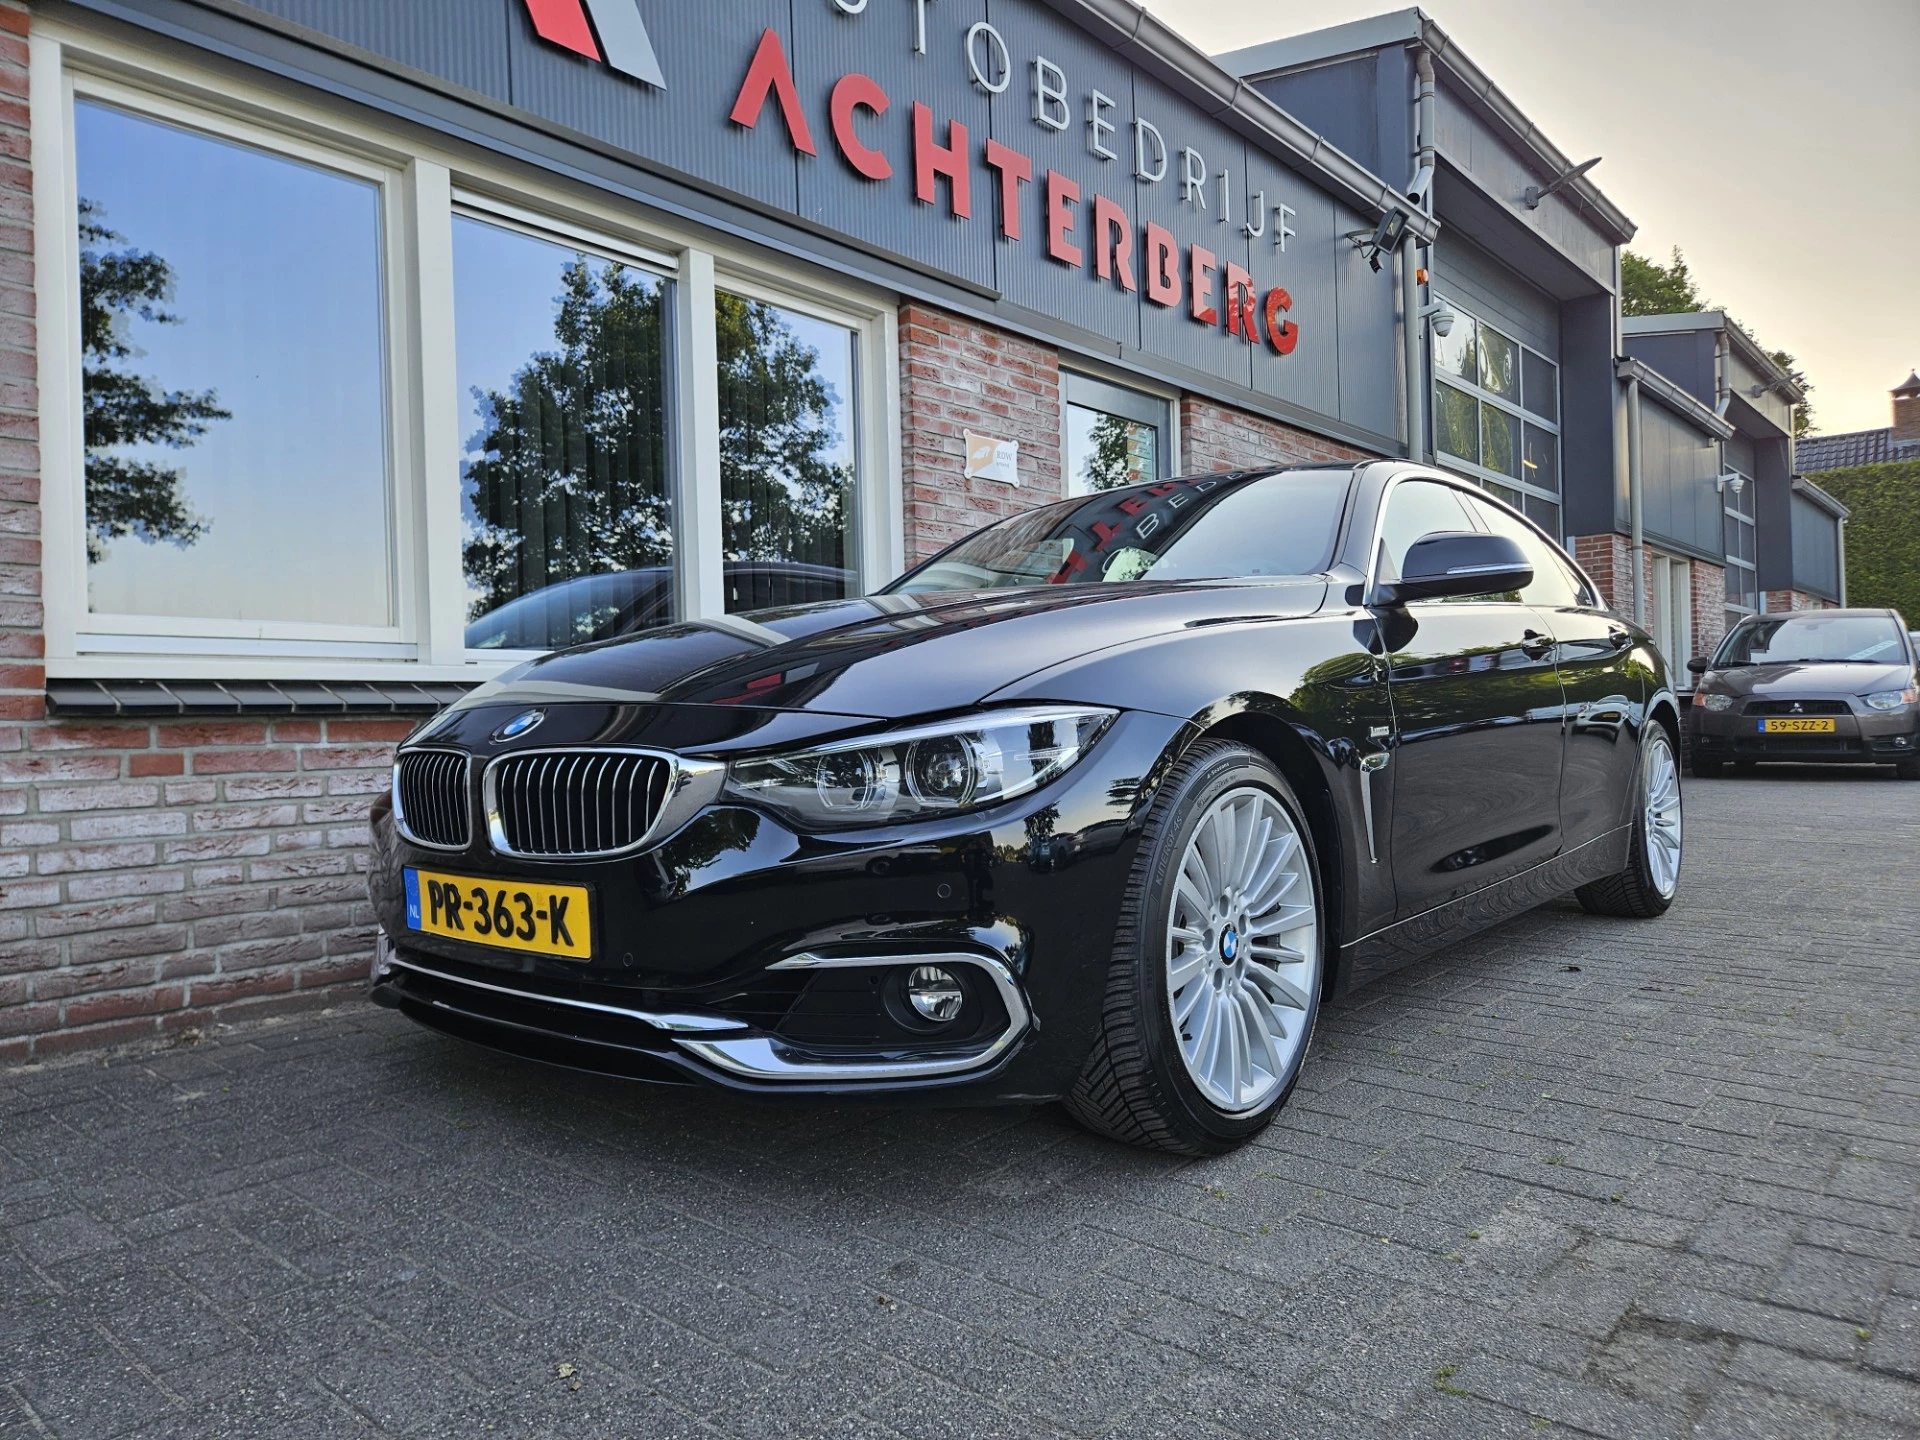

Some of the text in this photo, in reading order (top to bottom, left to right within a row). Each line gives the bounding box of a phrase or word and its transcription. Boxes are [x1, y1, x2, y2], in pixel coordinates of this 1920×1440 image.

[832, 0, 1296, 253] TOBEDRIJF
[729, 26, 1299, 356] ACHTERBERG
[1771, 720, 1829, 731] 59-SZZ-2
[409, 903, 420, 919] NL
[427, 879, 574, 946] PR-363-K
